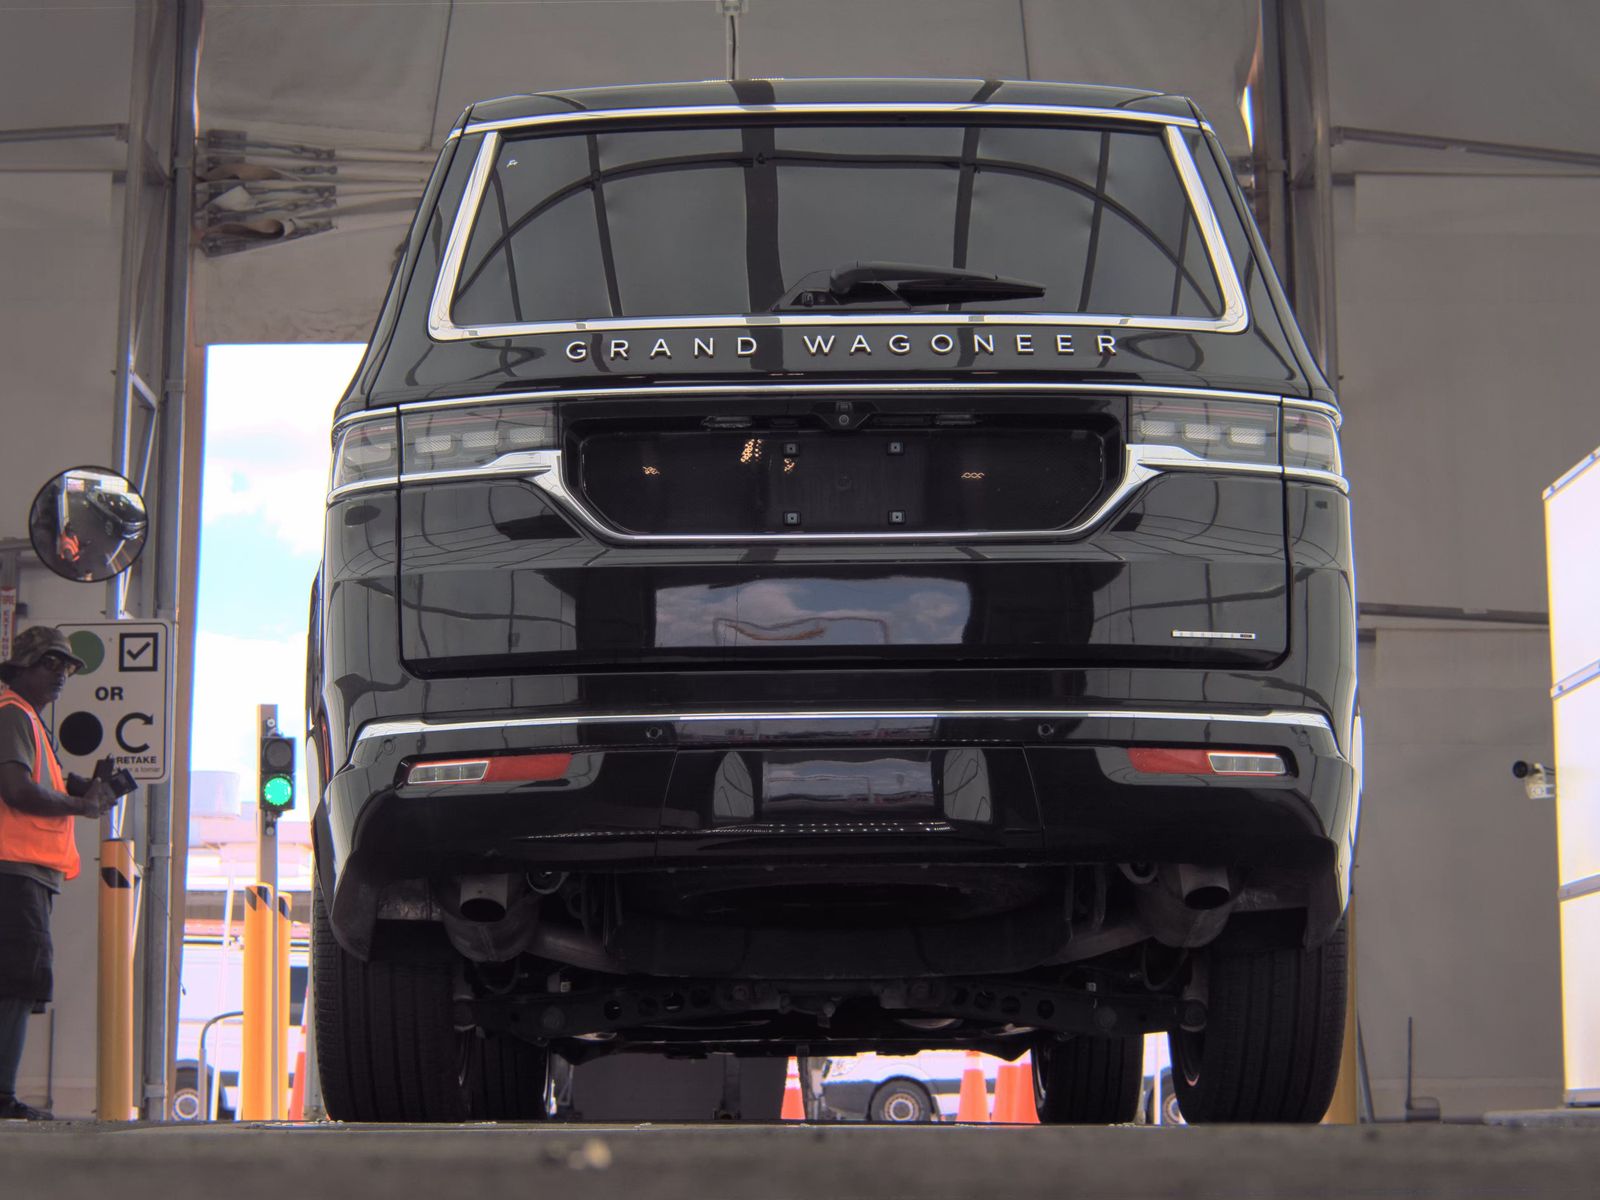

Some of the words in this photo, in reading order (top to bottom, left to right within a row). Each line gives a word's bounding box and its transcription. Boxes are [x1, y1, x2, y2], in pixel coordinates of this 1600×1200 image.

[565, 337, 758, 360] GRAND
[803, 334, 1118, 354] WAGONEER
[95, 686, 124, 701] OR
[116, 756, 157, 764] RETAKE
